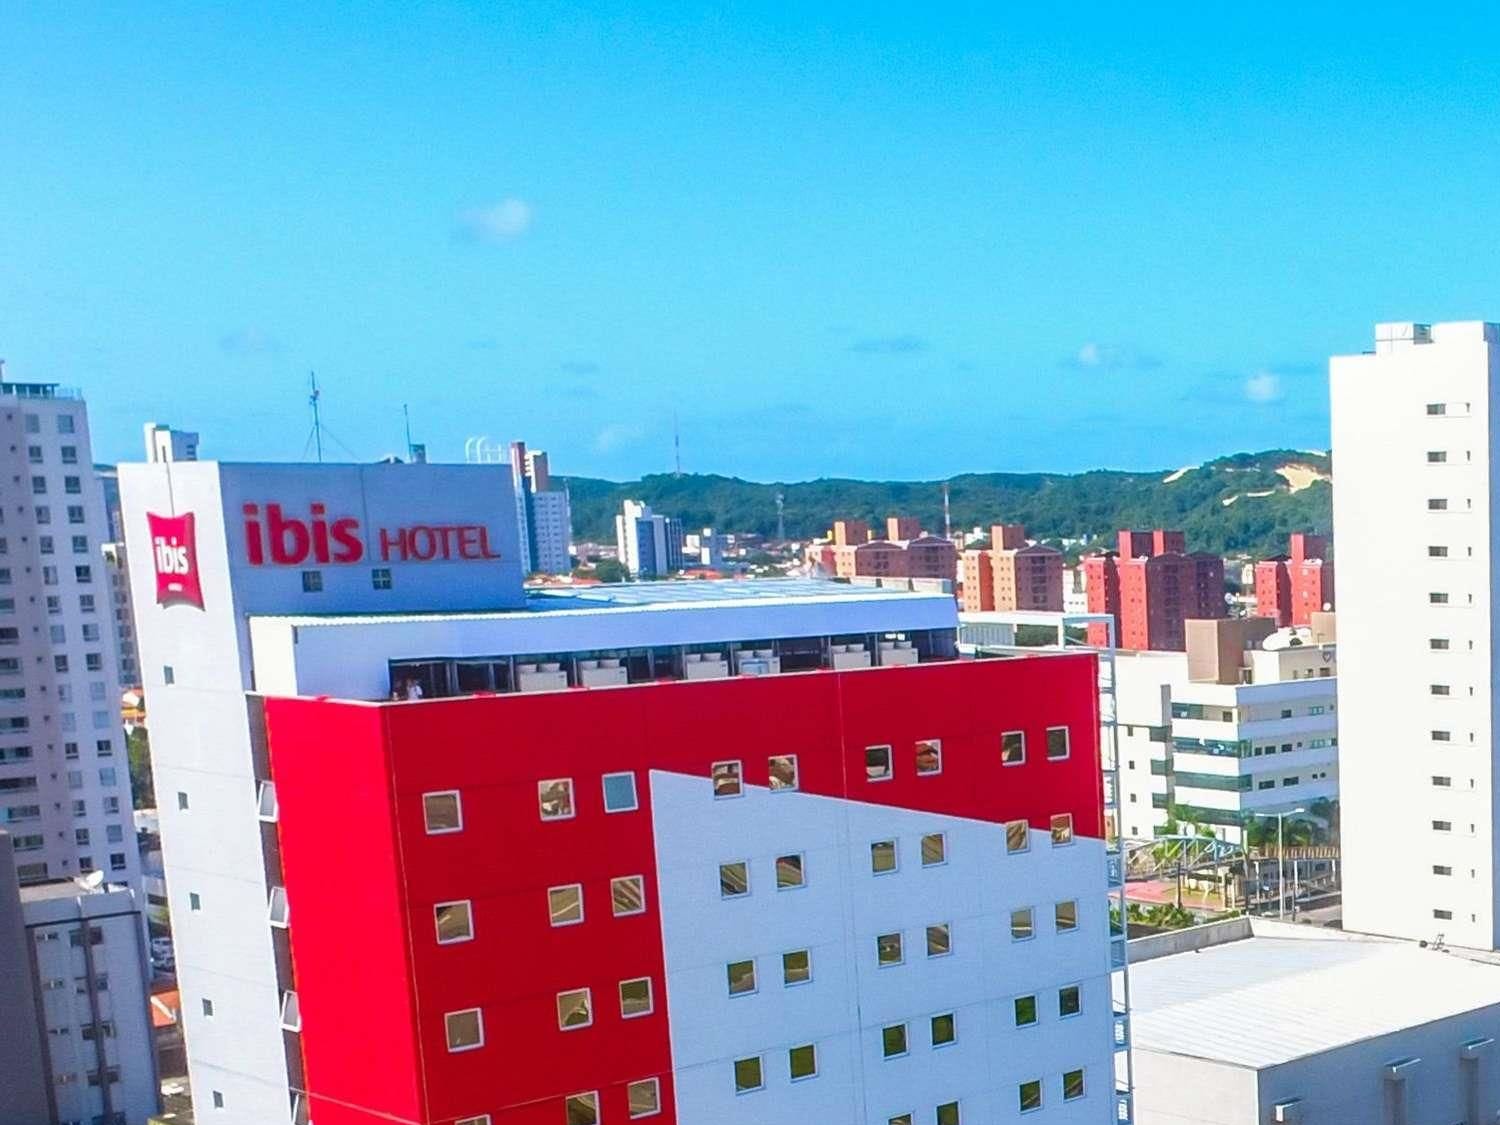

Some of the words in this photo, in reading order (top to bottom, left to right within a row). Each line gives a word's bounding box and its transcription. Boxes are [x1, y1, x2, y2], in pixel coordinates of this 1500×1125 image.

[154, 537, 189, 575] ibis
[243, 503, 363, 566] ibis
[380, 526, 501, 562] HOTEL
